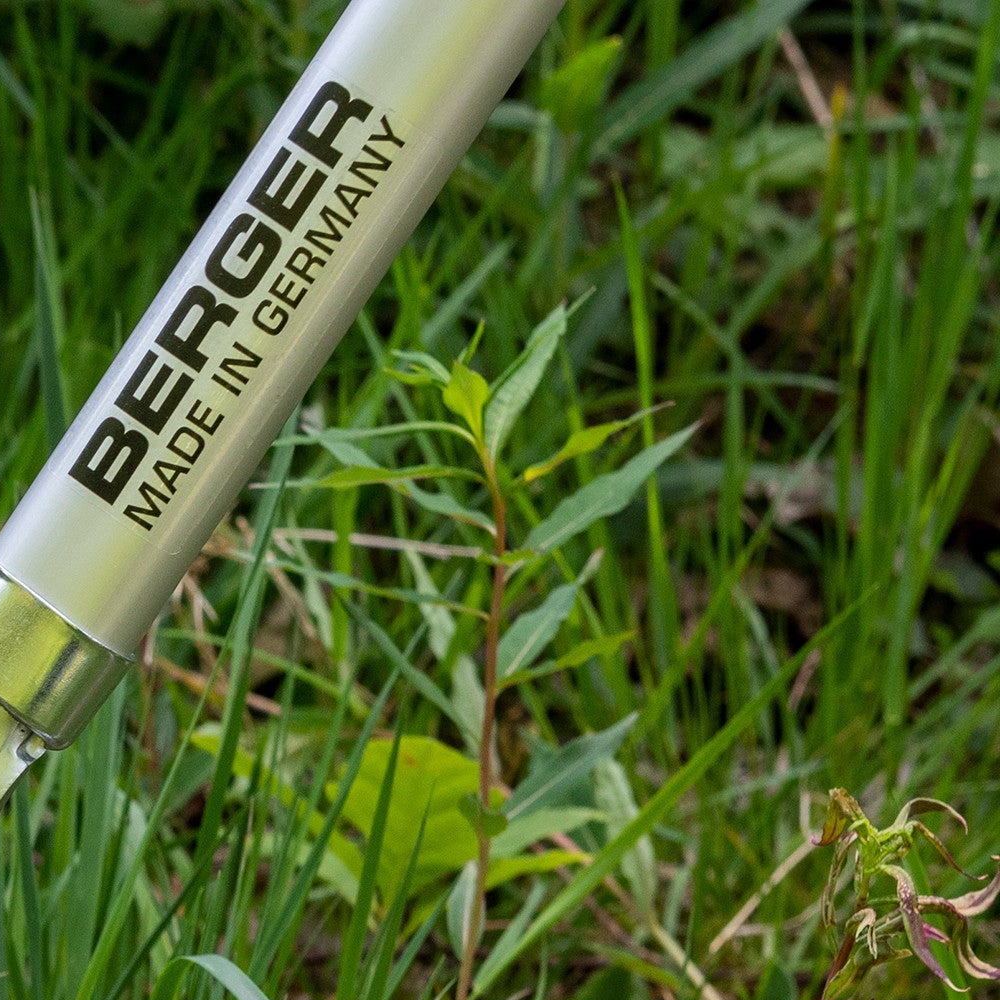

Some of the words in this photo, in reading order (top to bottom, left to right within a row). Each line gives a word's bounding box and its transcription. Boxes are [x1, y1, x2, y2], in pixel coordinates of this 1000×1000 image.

[68, 80, 374, 506] BERGER
[123, 400, 225, 531] MADE
[211, 341, 263, 397] IN
[252, 115, 406, 337] GERMANY
